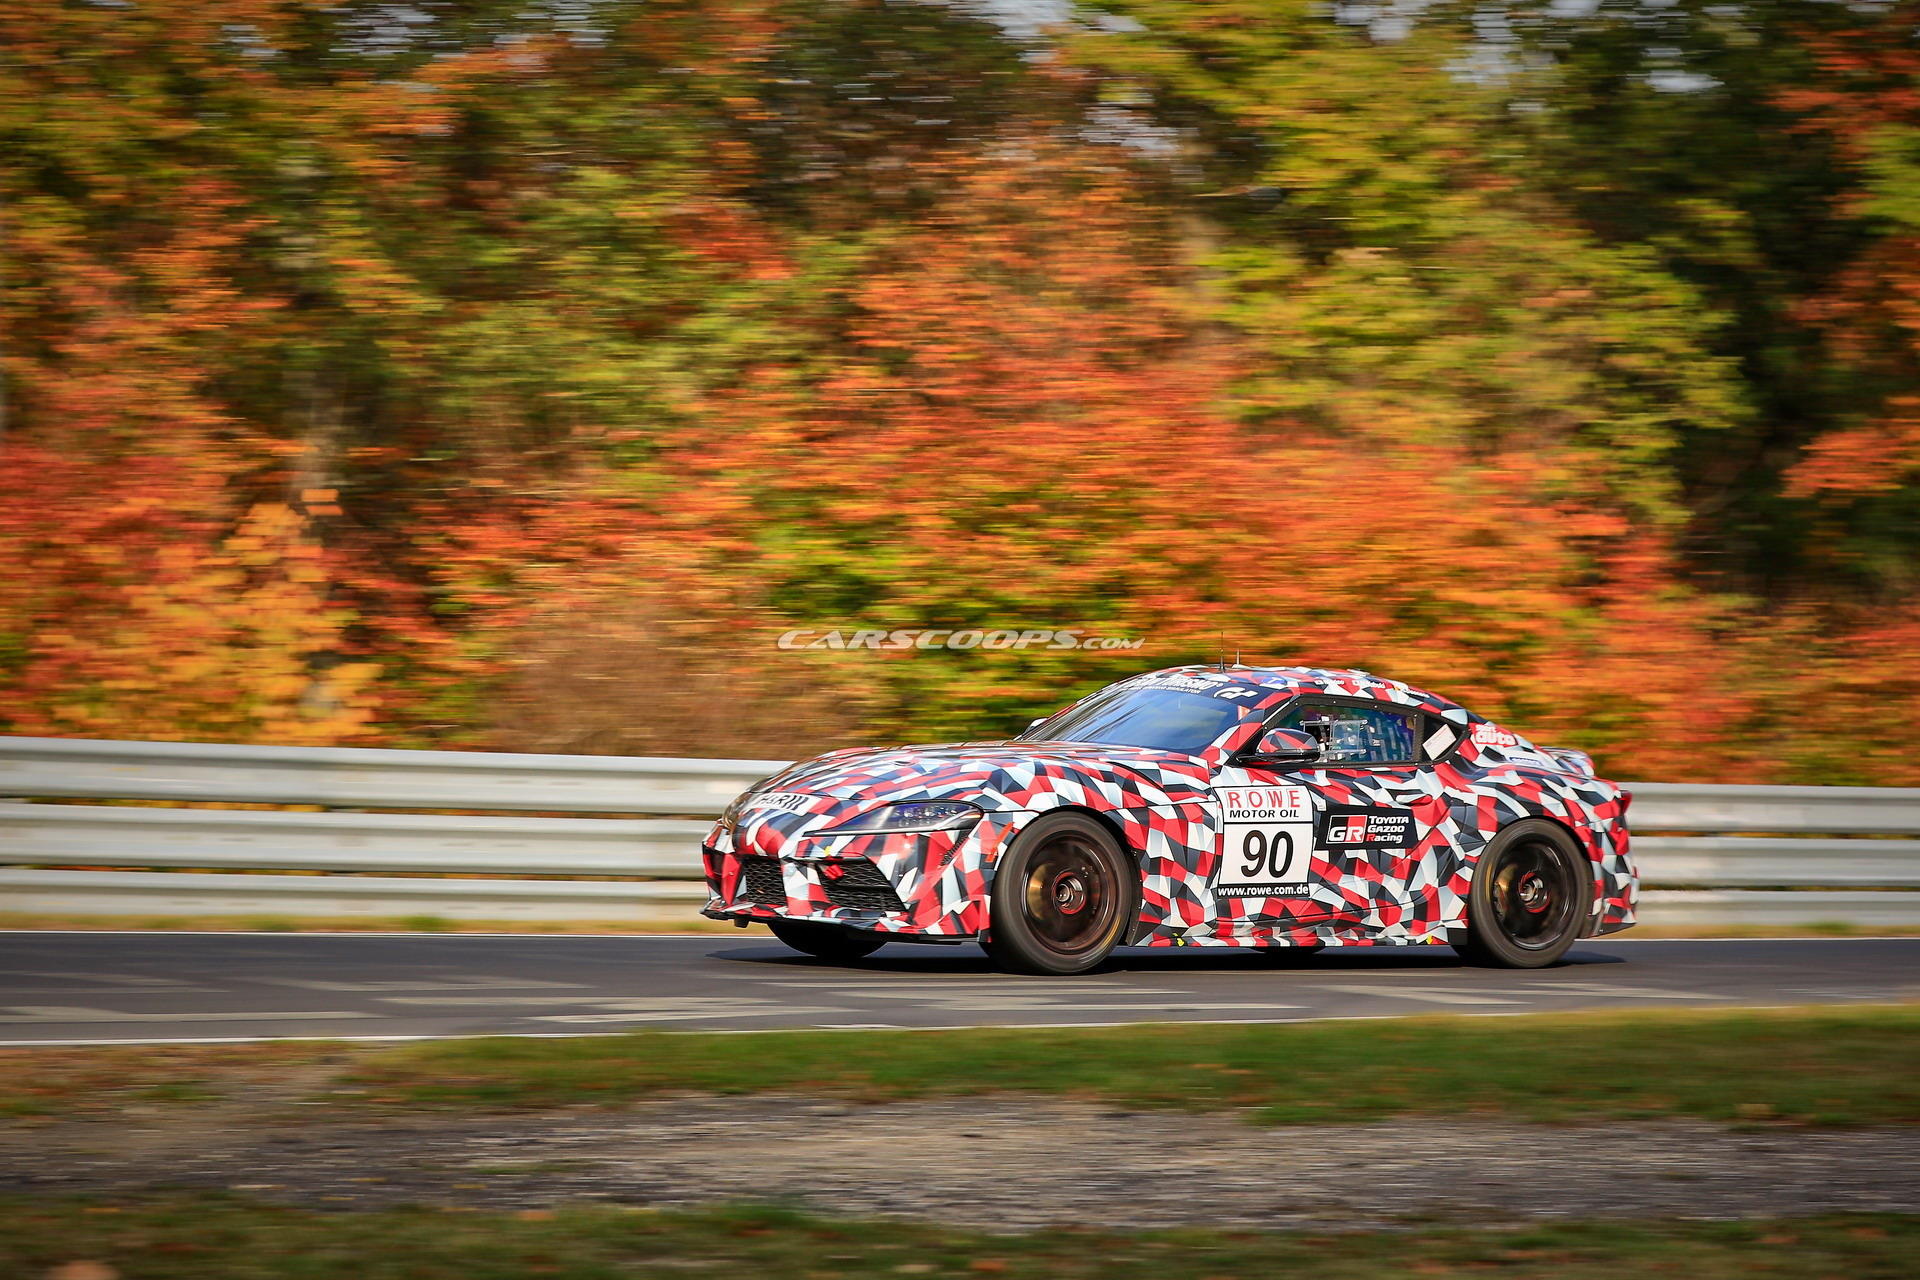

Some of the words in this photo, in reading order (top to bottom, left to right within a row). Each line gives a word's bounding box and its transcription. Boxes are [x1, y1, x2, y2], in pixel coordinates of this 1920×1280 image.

[1475, 730, 1517, 746] auto
[1227, 790, 1301, 809] ROWE
[1229, 809, 1276, 819] MOTOR
[1279, 809, 1300, 818] OIL
[1368, 815, 1409, 824] TOYOTA
[1328, 826, 1364, 842] GR
[1367, 825, 1406, 833] GAZOO
[1365, 833, 1404, 844] Racing
[1240, 829, 1294, 879] 90
[1217, 884, 1309, 896] www.rowe.com.de
